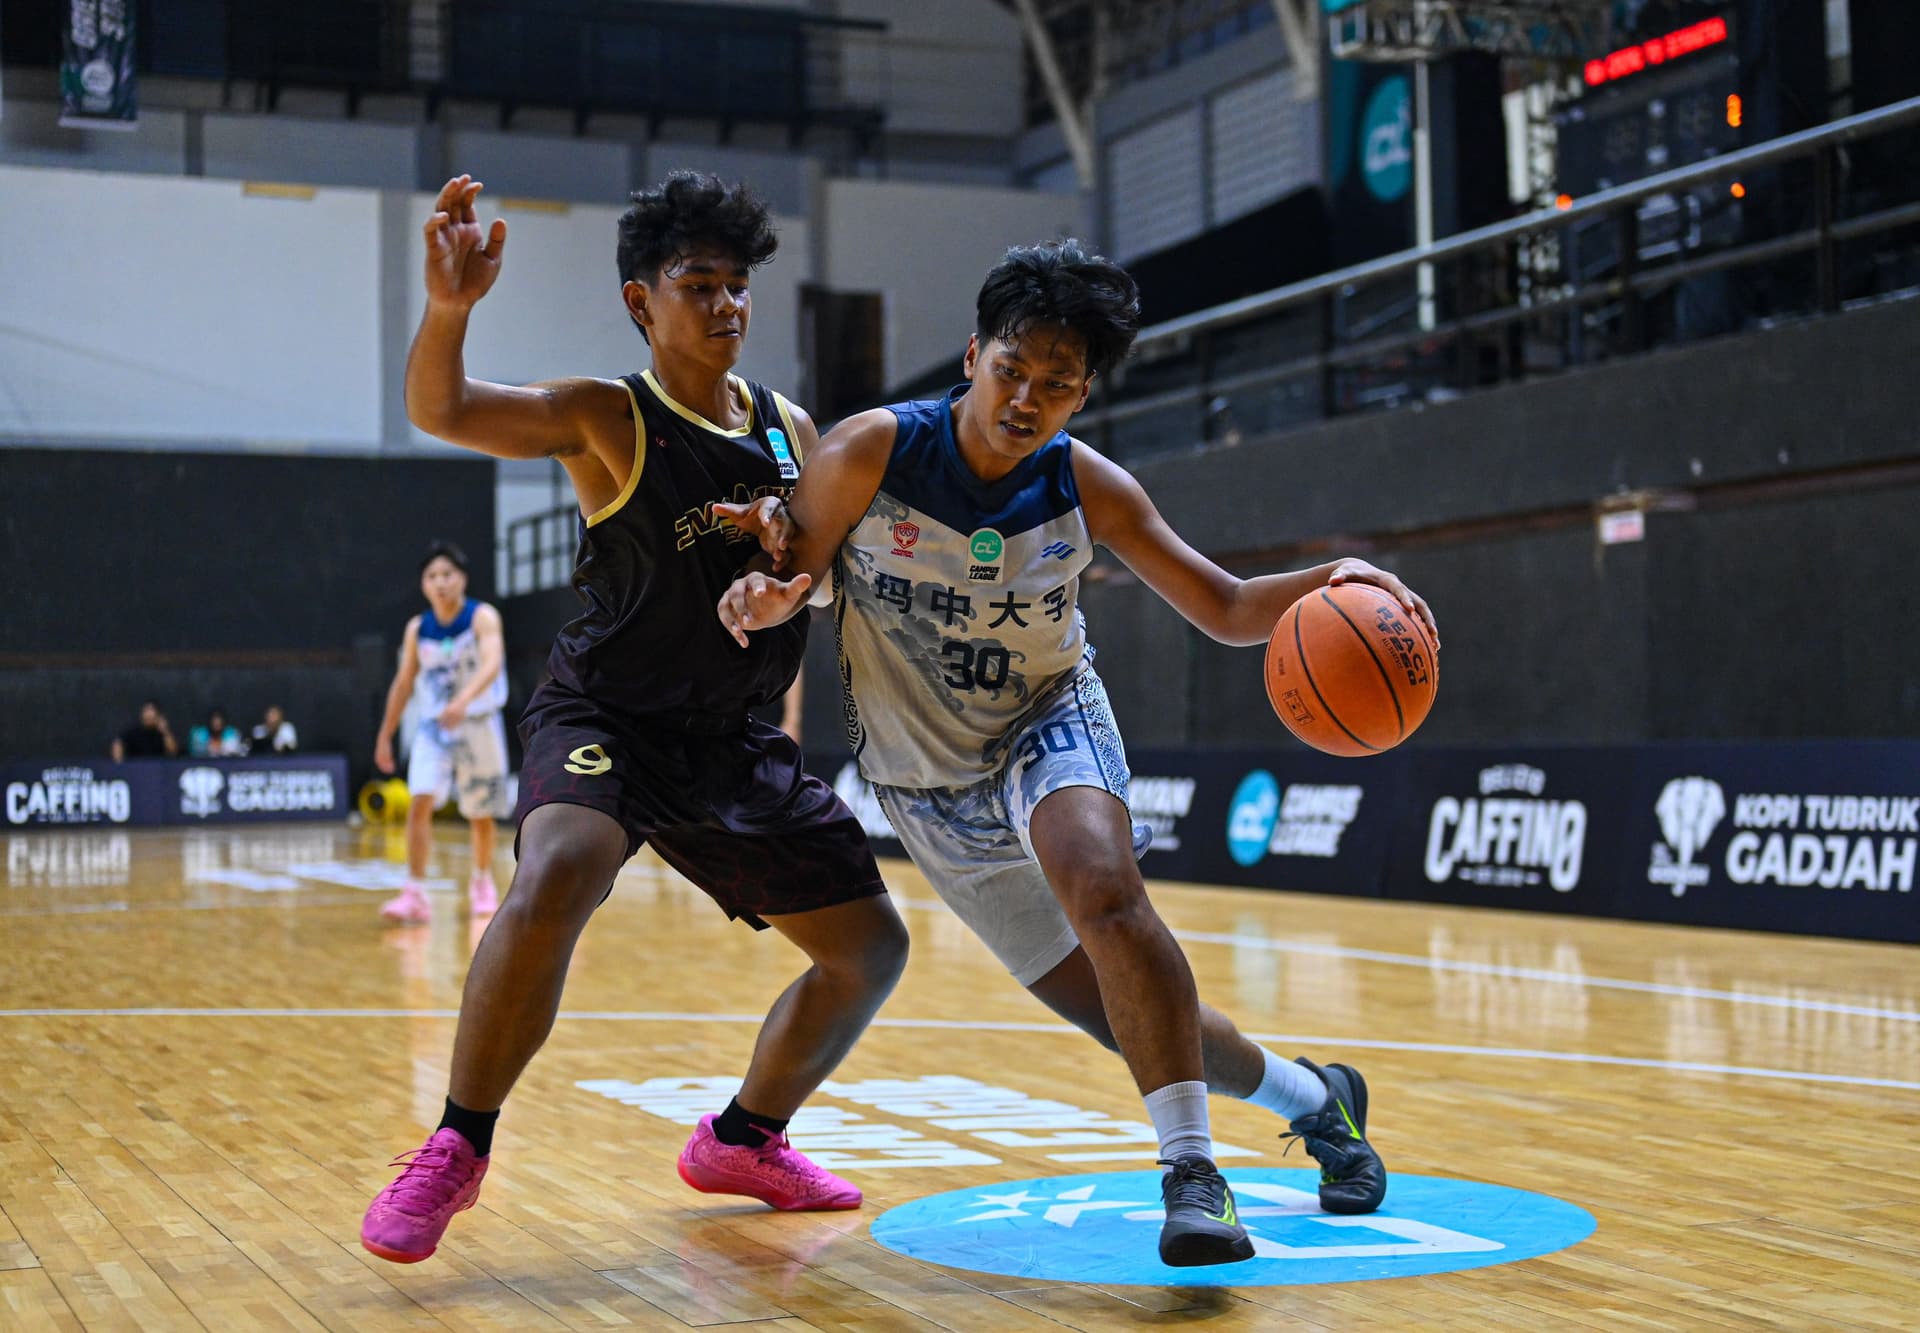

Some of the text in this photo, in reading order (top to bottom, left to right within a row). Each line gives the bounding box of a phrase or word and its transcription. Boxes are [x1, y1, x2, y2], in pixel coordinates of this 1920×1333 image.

[969, 565, 1001, 573] CAMPUS
[969, 572, 998, 580] LEAGUE
[942, 641, 1010, 691] 30
[1376, 606, 1428, 684] REACT
[564, 744, 612, 775] 9
[1016, 721, 1078, 772] 30
[1734, 793, 1920, 832] KOPI TUBRUK
[1725, 831, 1918, 892] GADJAH
